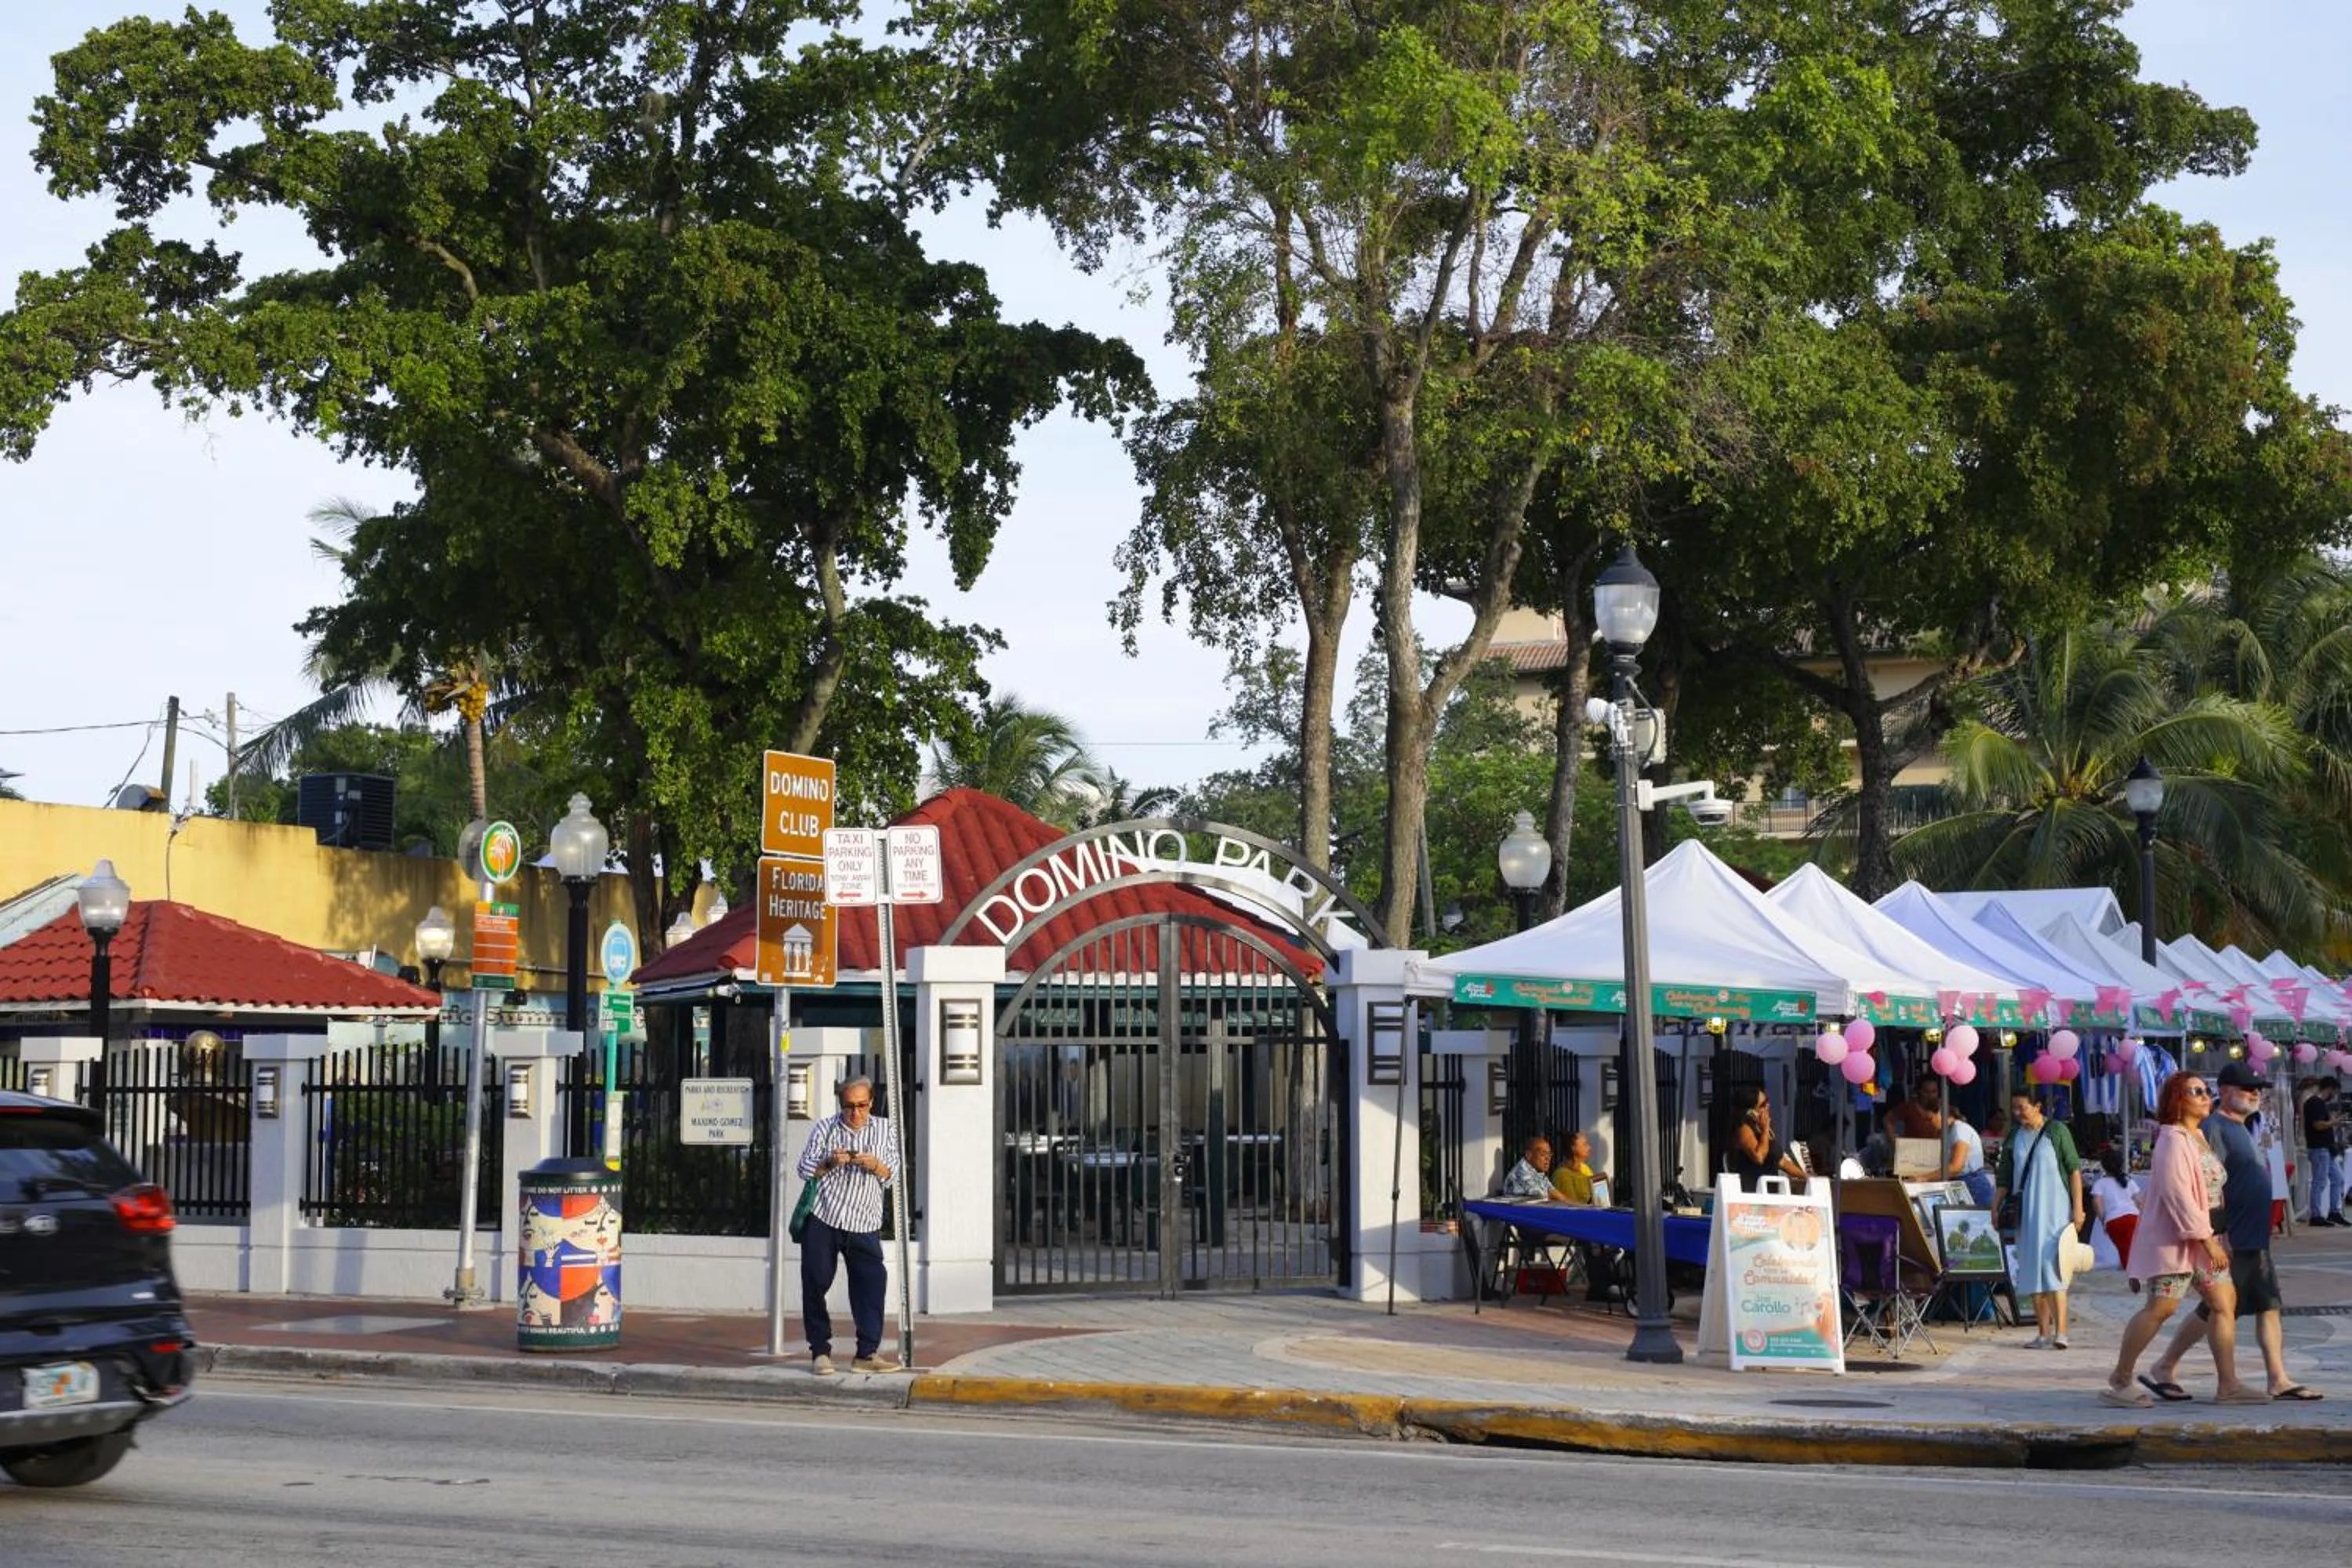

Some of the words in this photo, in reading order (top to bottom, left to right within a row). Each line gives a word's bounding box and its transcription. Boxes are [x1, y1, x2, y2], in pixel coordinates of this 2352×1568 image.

[771, 771, 829, 802] DOMINO
[779, 810, 820, 838] CLUB
[837, 833, 864, 844] TAXI
[904, 832, 921, 844] NO
[828, 846, 873, 858] PARKING
[893, 845, 935, 856] PARKING
[837, 860, 863, 872] ONLY
[905, 858, 924, 869] ANY
[771, 866, 824, 892] FLORIDA
[902, 869, 928, 881] TIME
[975, 829, 1187, 943] DOMINO
[1214, 836, 1356, 928] PARK
[768, 894, 828, 920] HERITAGE
[1741, 1299, 1791, 1313] Carollo
